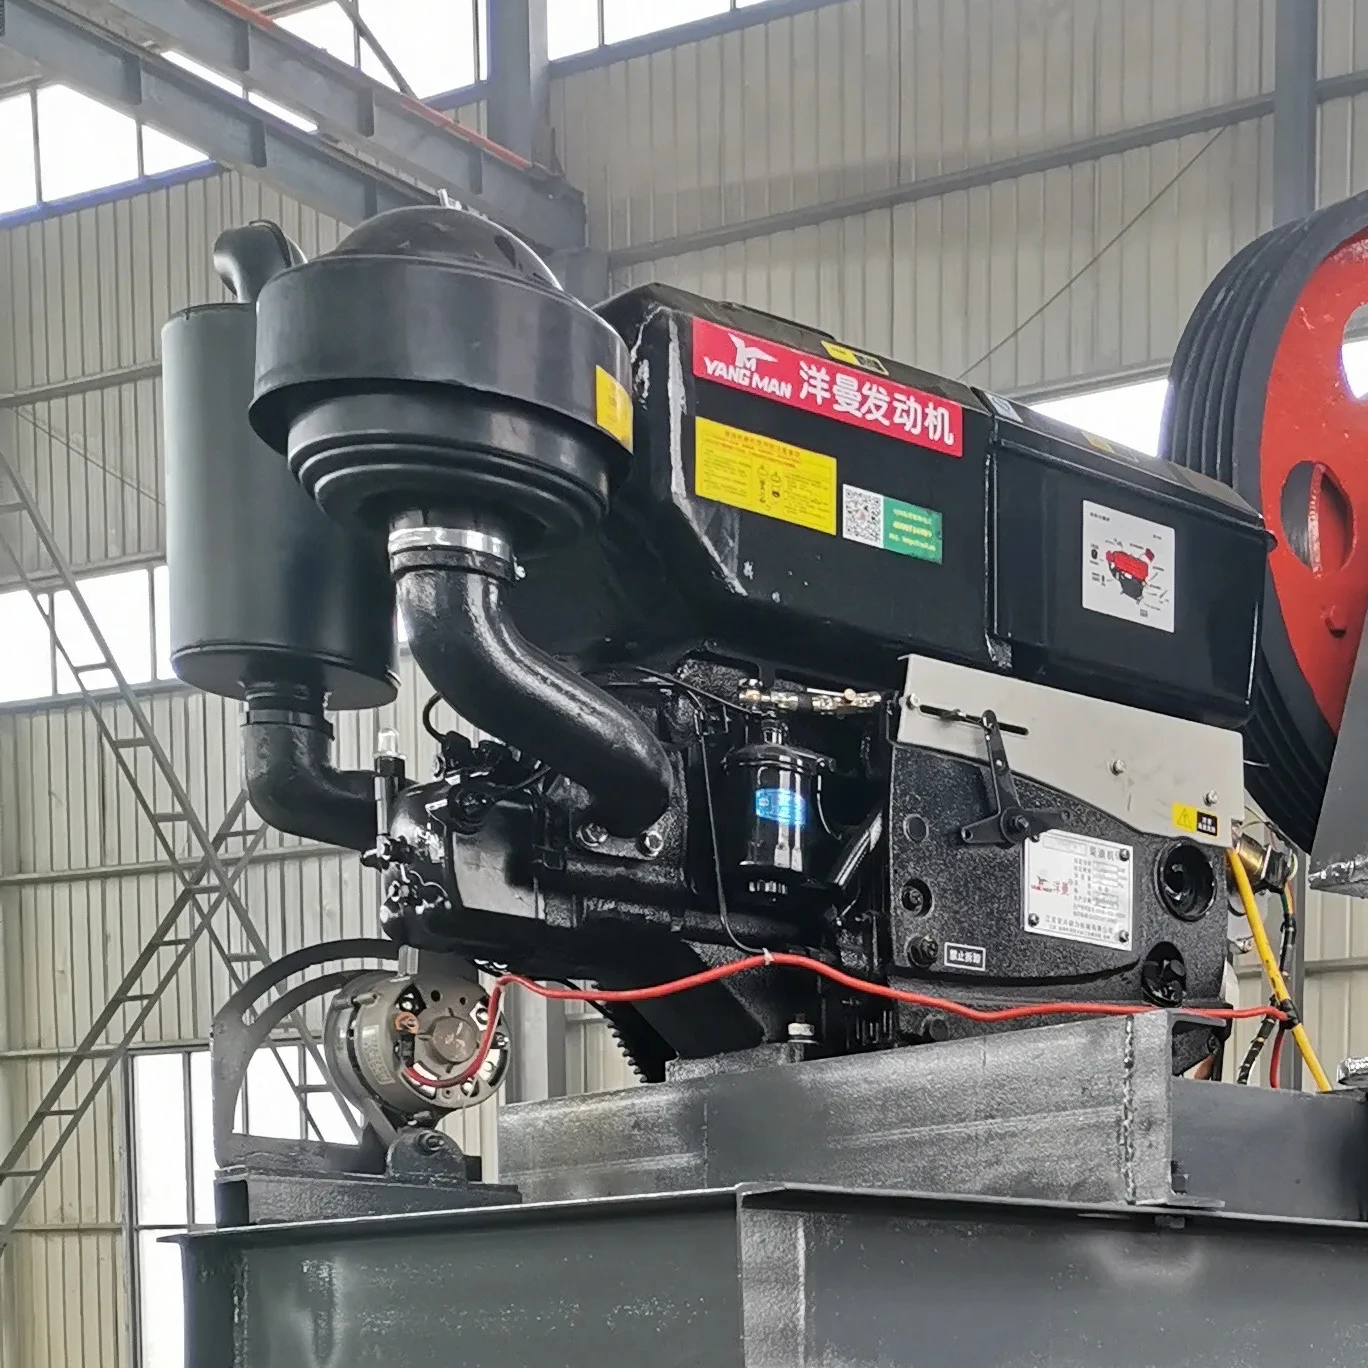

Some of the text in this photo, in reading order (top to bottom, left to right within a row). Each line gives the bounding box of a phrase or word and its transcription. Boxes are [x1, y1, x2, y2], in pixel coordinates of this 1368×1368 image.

[703, 356, 793, 400] YANG MAN
[799, 360, 955, 446] 洋曼发动机
